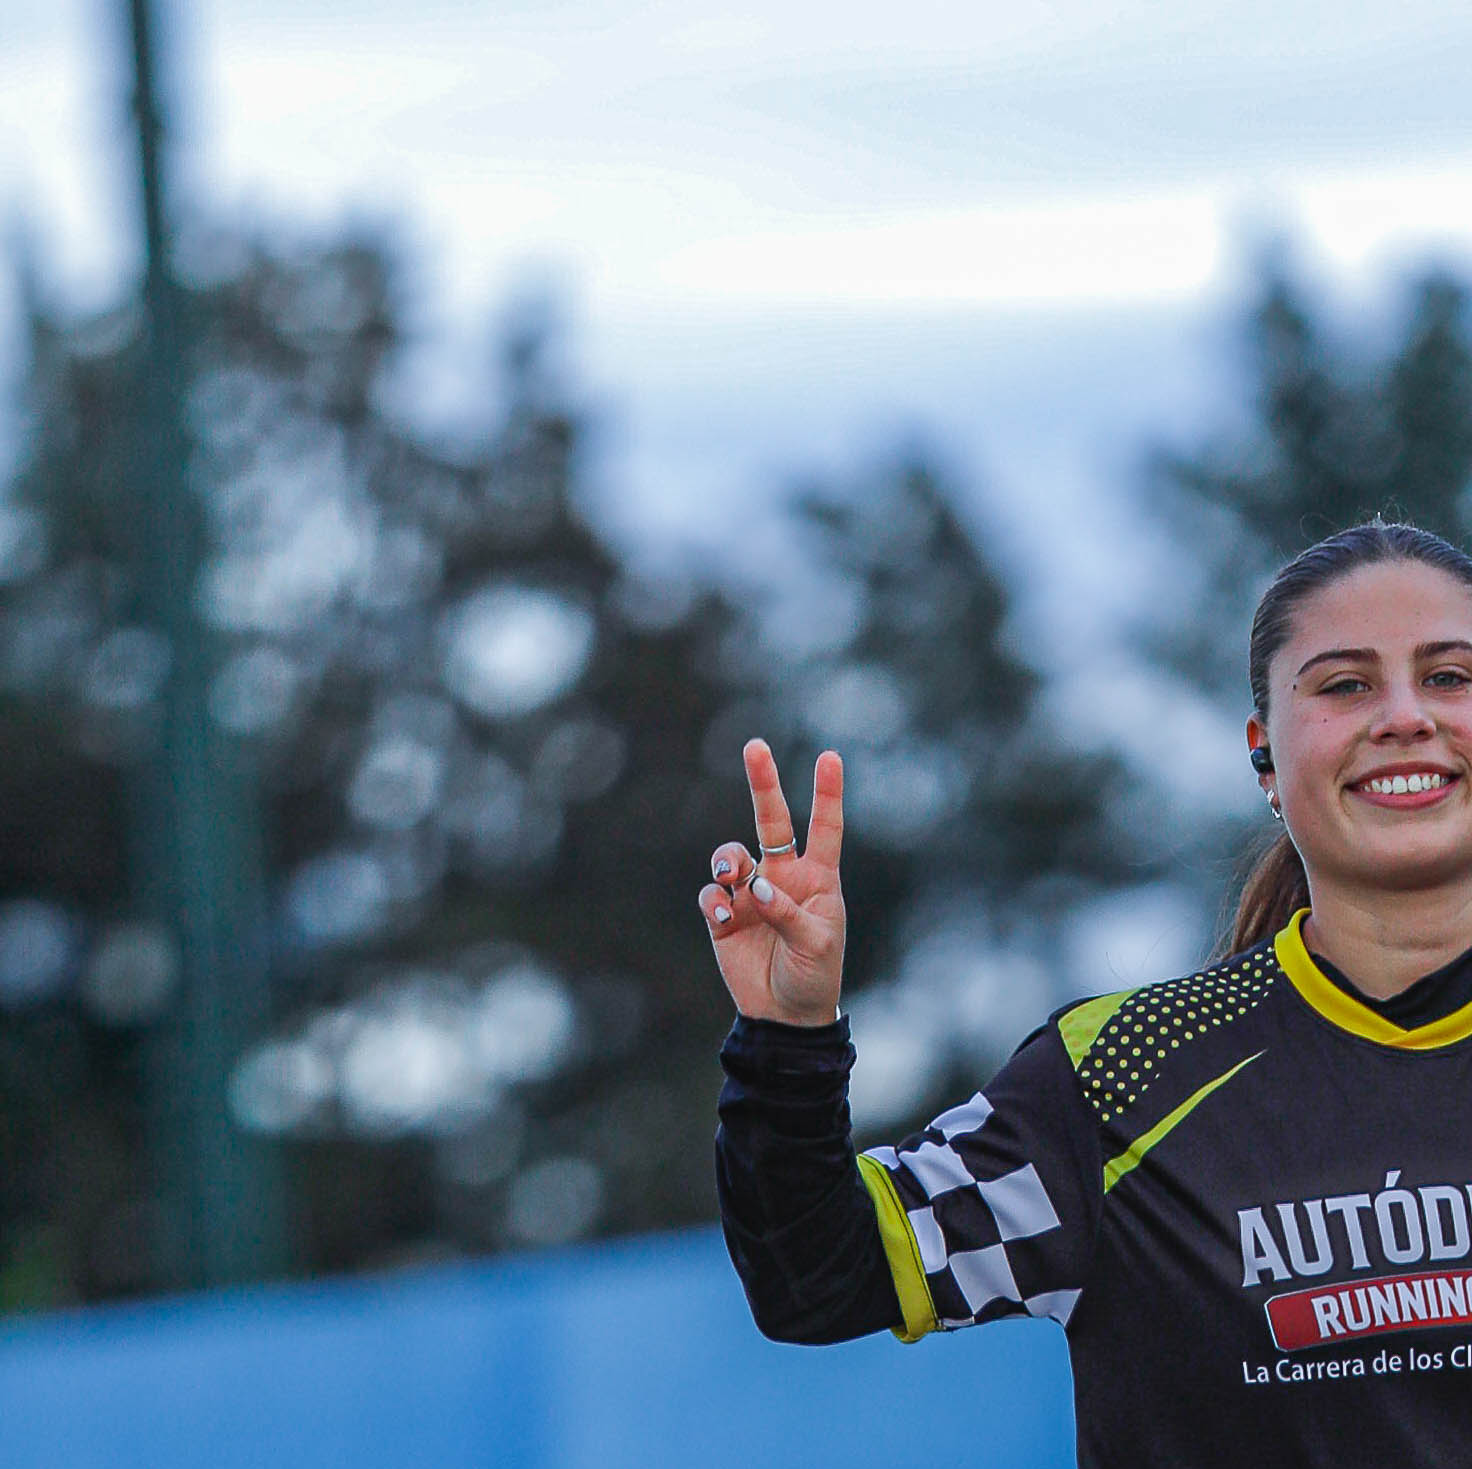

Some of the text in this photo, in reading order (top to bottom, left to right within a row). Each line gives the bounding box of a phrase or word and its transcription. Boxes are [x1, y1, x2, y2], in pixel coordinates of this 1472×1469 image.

[1242, 1361, 1270, 1384] La
[1275, 1357, 1365, 1382] Carrera
[1372, 1350, 1403, 1373] de
[1409, 1347, 1444, 1371] los
